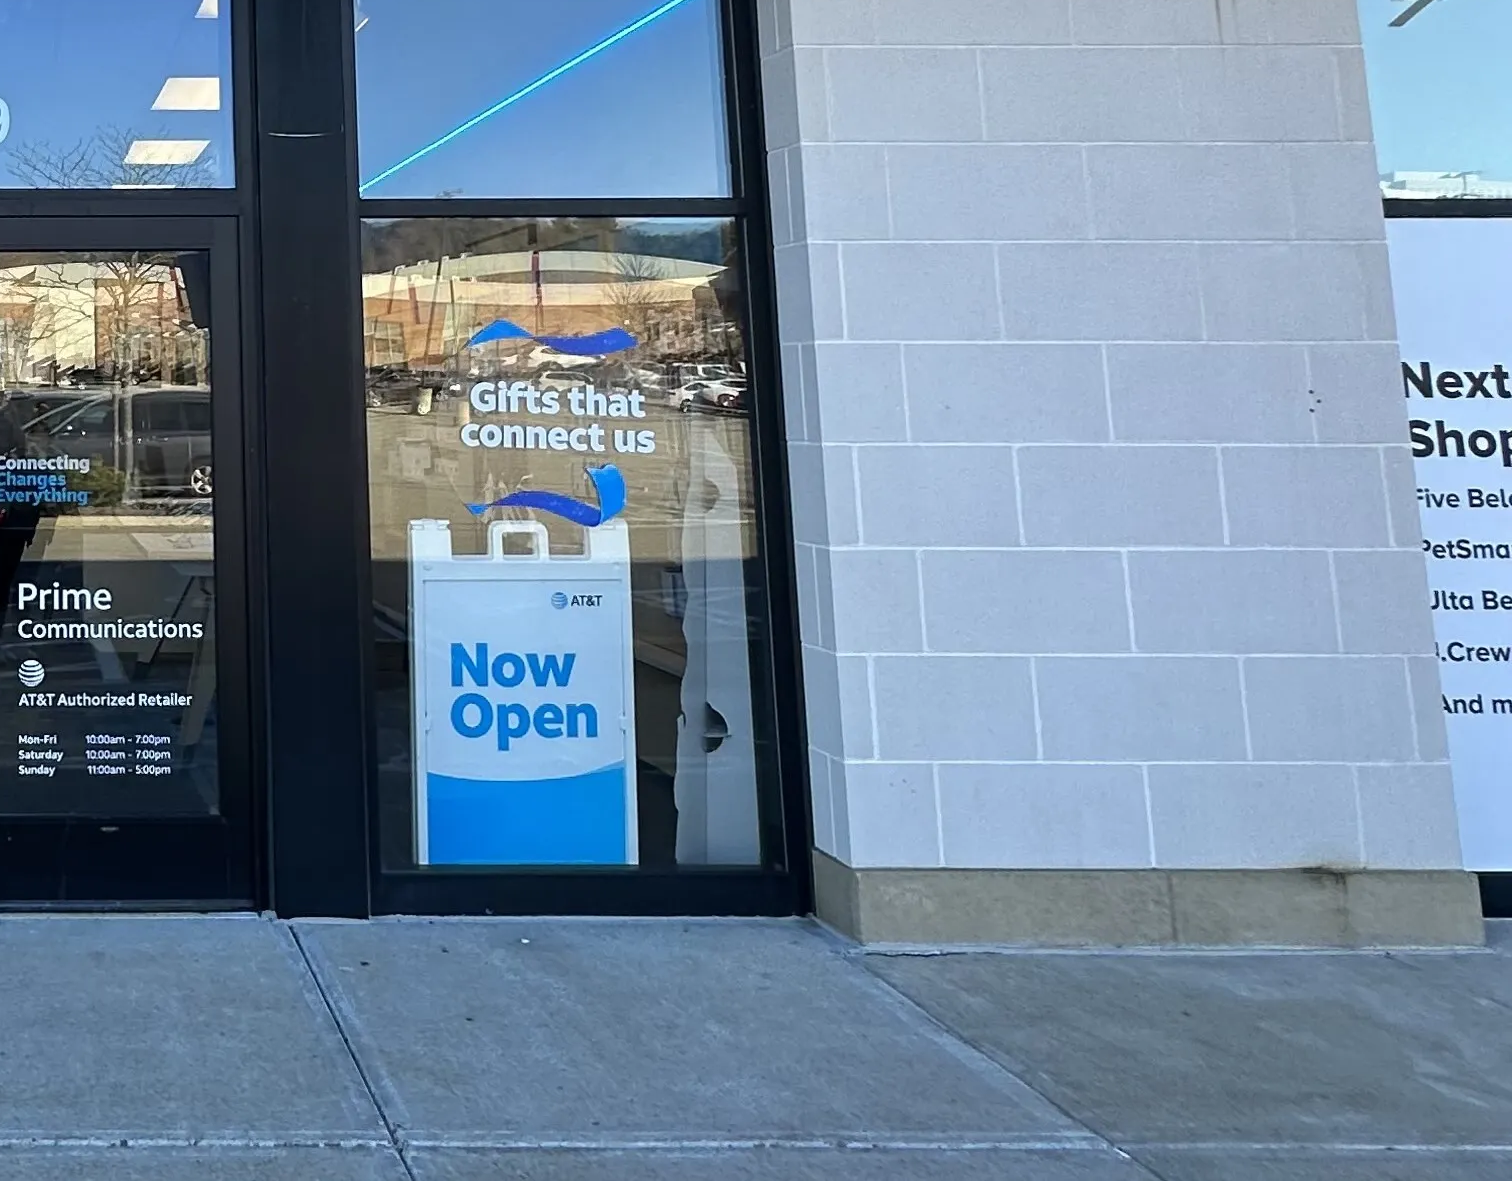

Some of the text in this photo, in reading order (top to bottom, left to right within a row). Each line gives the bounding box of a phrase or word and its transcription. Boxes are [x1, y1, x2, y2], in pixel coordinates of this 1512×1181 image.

[1399, 361, 1512, 399] Next
[470, 381, 646, 418] Gifts that
[461, 423, 656, 454] connect us
[1467, 488, 1512, 508] Bel
[18, 581, 113, 611] Prime
[570, 595, 602, 607] AT&T
[17, 619, 203, 639] Communications
[450, 642, 577, 688] Now
[18, 693, 193, 707] AT&T Authorized Retailer
[450, 693, 599, 752] Open
[18, 734, 58, 745] Mon-Fri
[85, 734, 126, 745] 10:00am
[135, 734, 171, 746] 7:00pm
[18, 749, 64, 762] Saturday
[85, 749, 126, 760] 10:00am
[135, 749, 171, 761] 7:00pm
[18, 765, 56, 777] Sunday
[87, 765, 126, 775] 11:00am
[135, 765, 171, 777] 5:00pm
